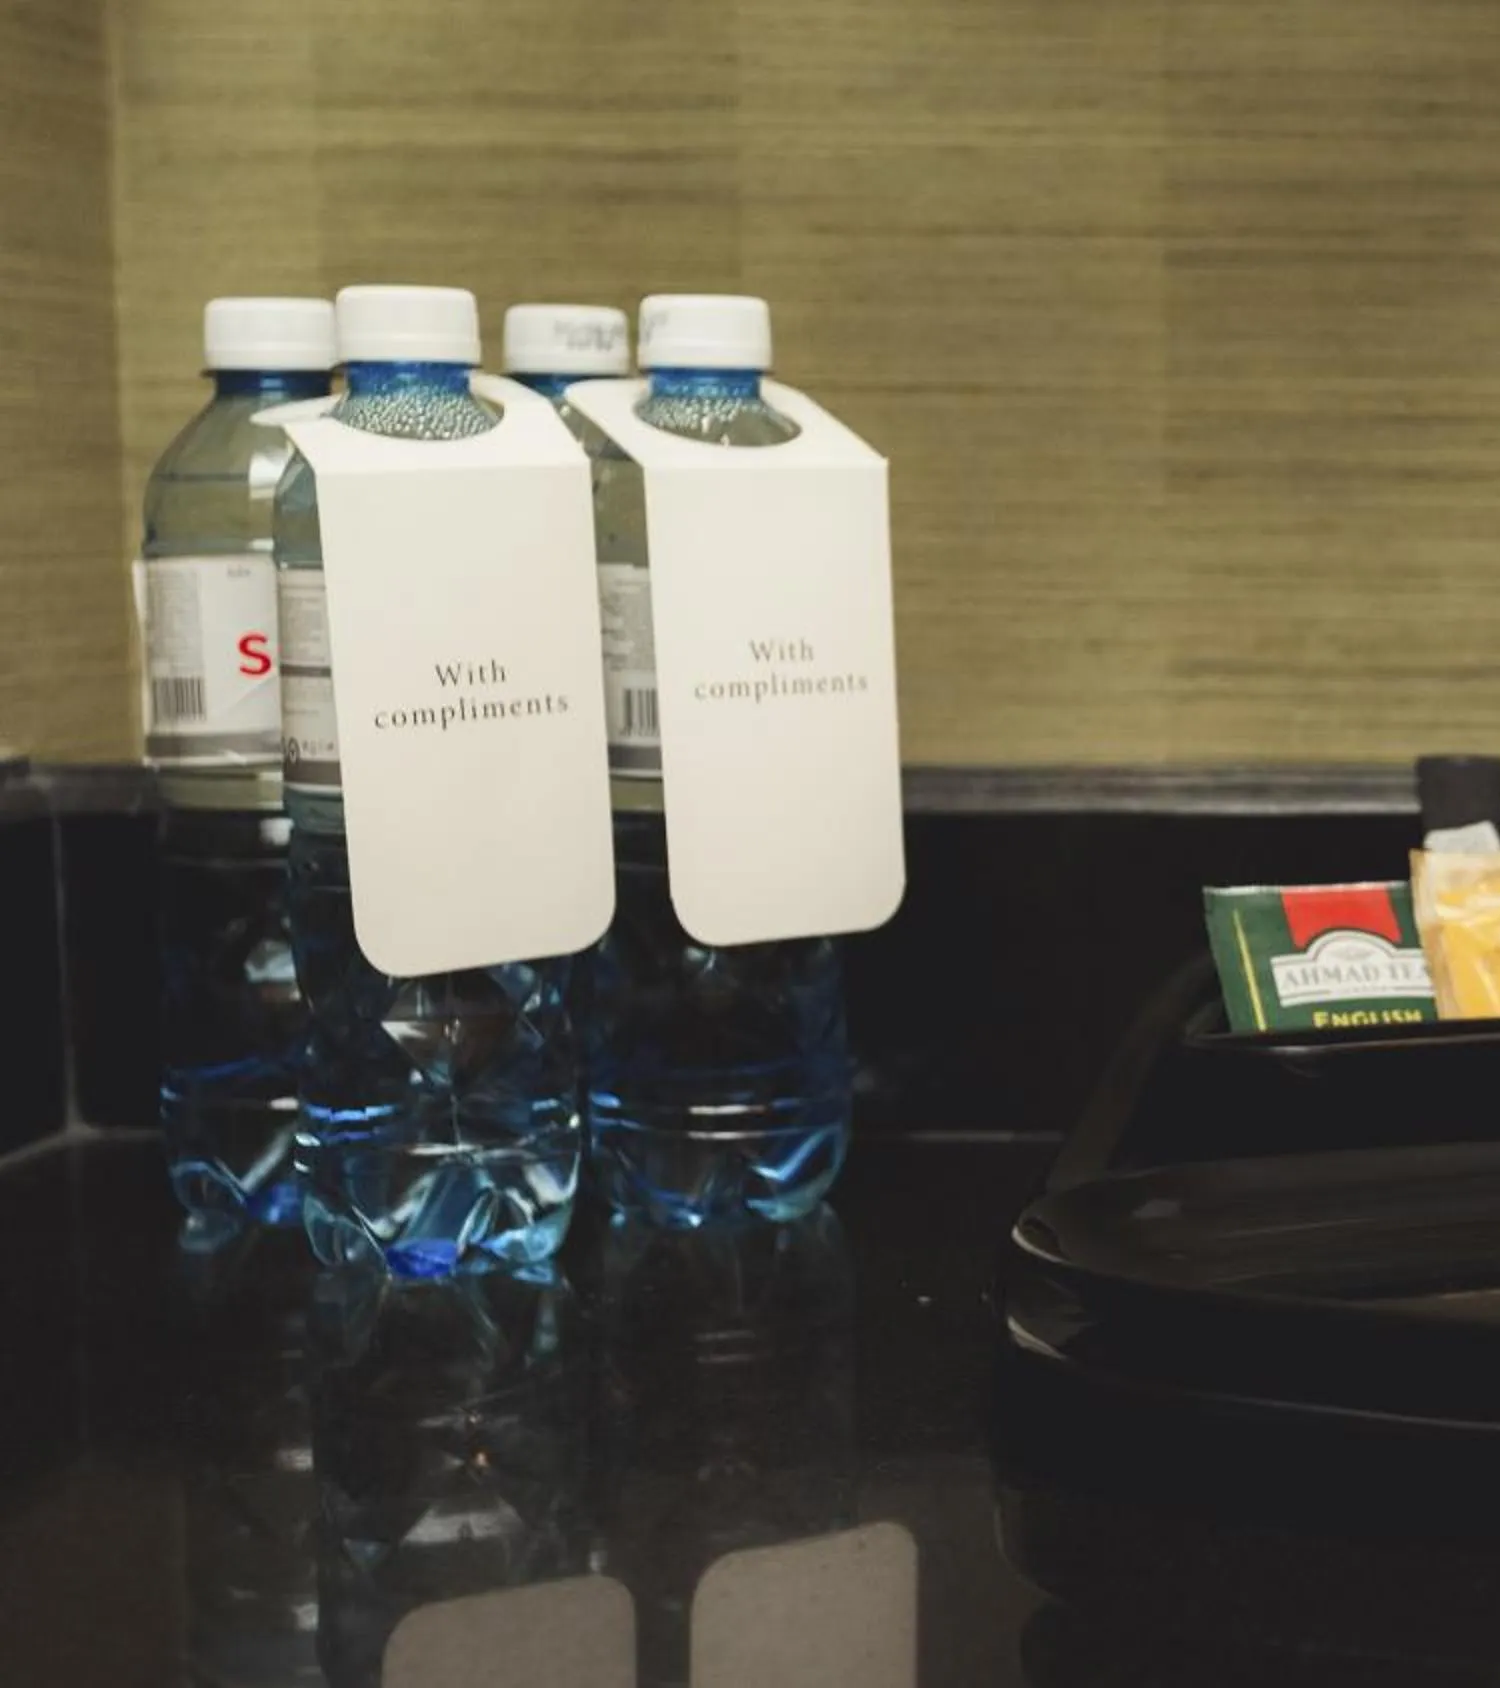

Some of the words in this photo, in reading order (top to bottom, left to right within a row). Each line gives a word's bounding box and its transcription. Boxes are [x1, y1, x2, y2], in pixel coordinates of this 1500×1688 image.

[748, 637, 816, 663] With
[434, 658, 507, 687] With
[693, 671, 869, 705] compliments
[374, 694, 570, 732] compliments
[1281, 962, 1381, 989] AHMAD
[1313, 1008, 1424, 1029] ENGLISH
